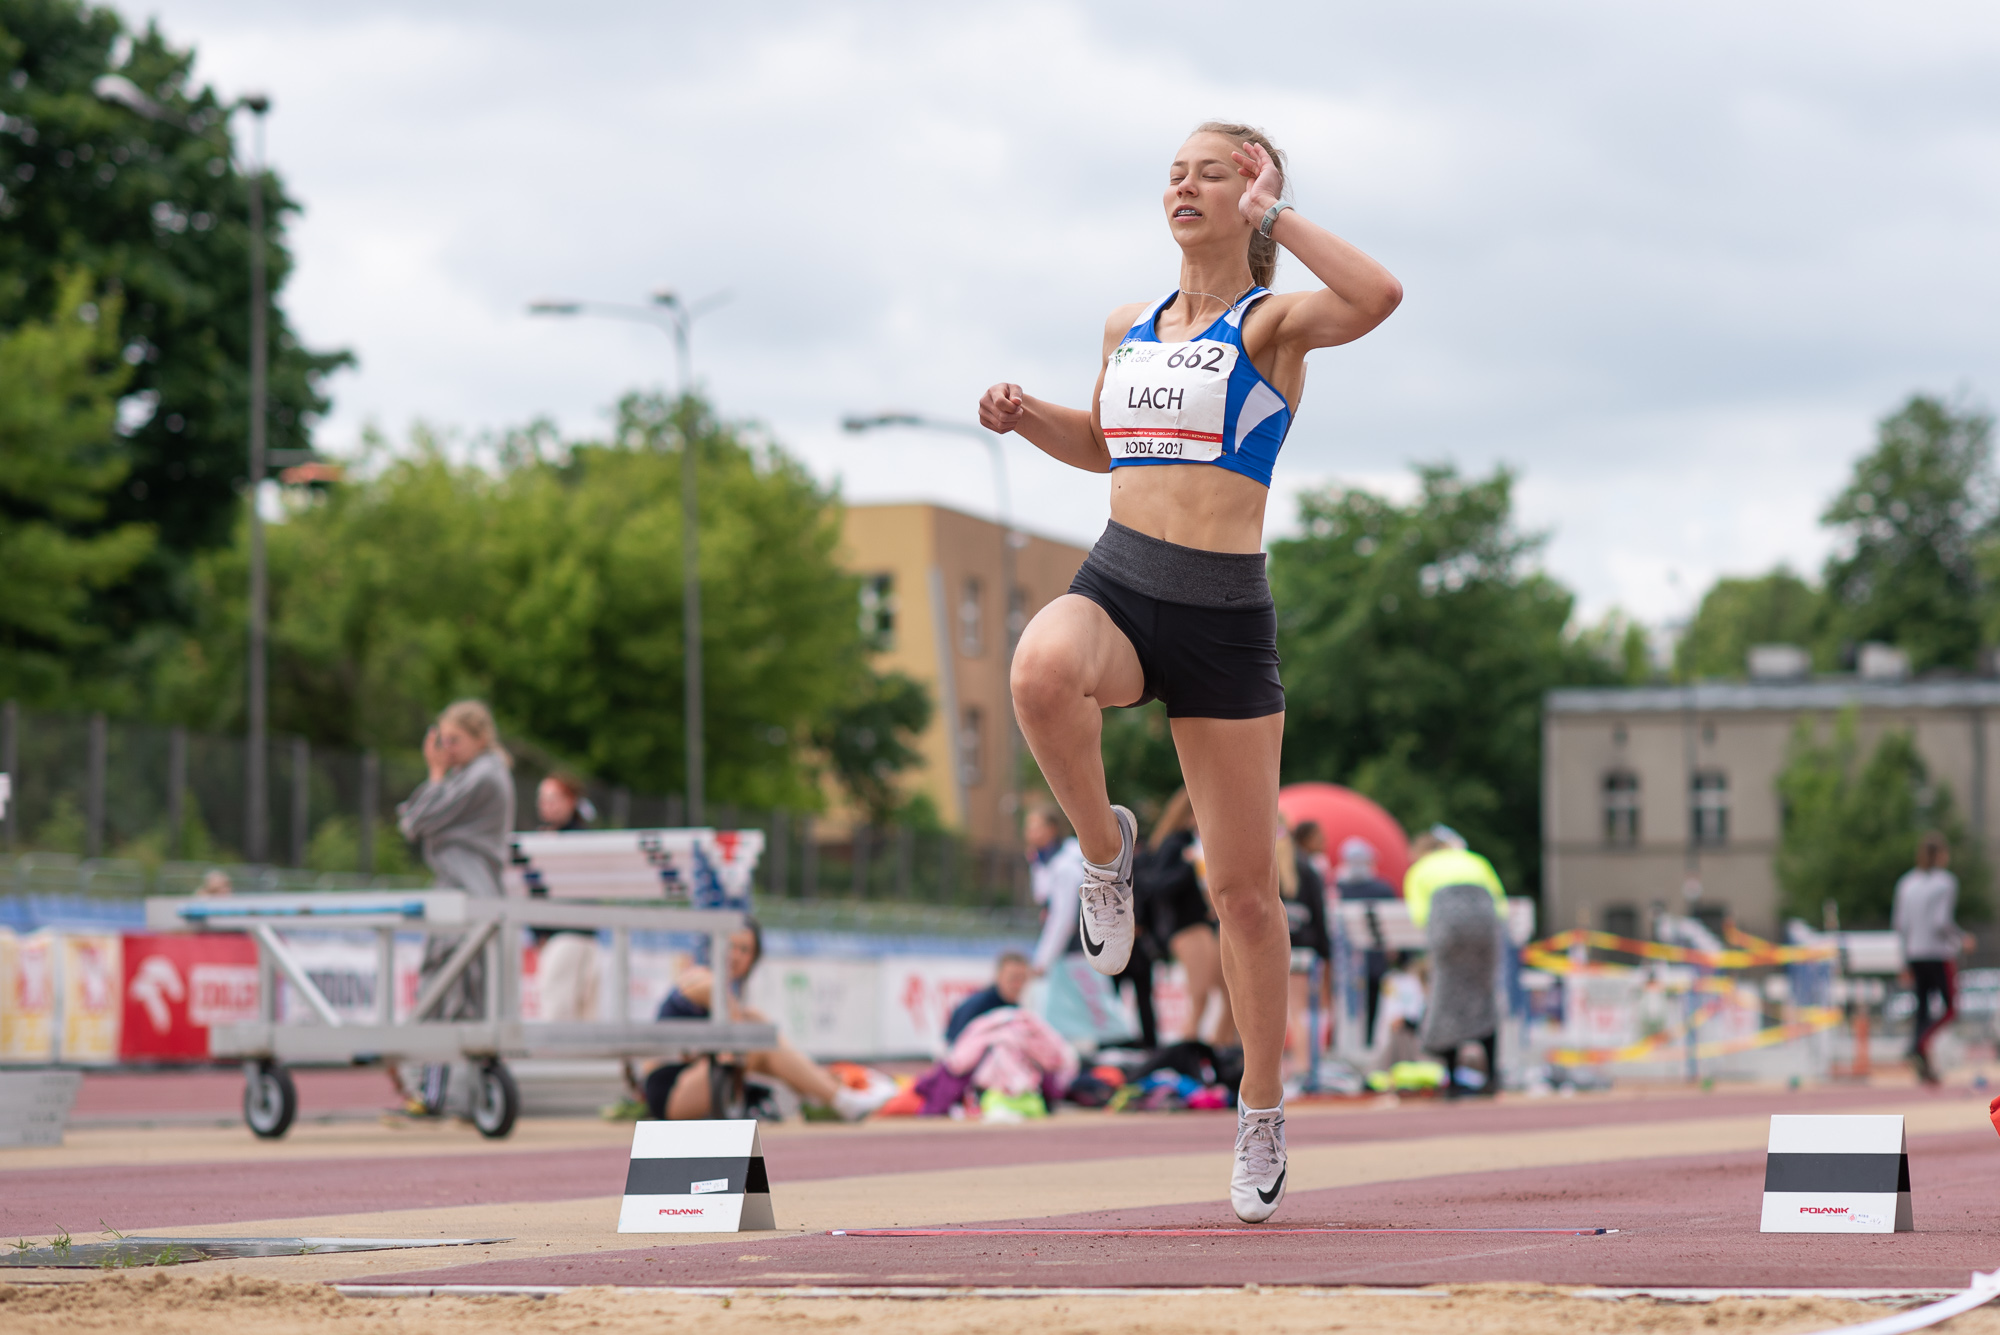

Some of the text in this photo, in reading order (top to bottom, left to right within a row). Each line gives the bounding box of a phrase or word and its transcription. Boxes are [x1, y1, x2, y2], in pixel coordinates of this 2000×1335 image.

[1166, 345, 1225, 373] 662
[1128, 386, 1184, 410] LACH
[659, 1208, 704, 1216] POLANIK
